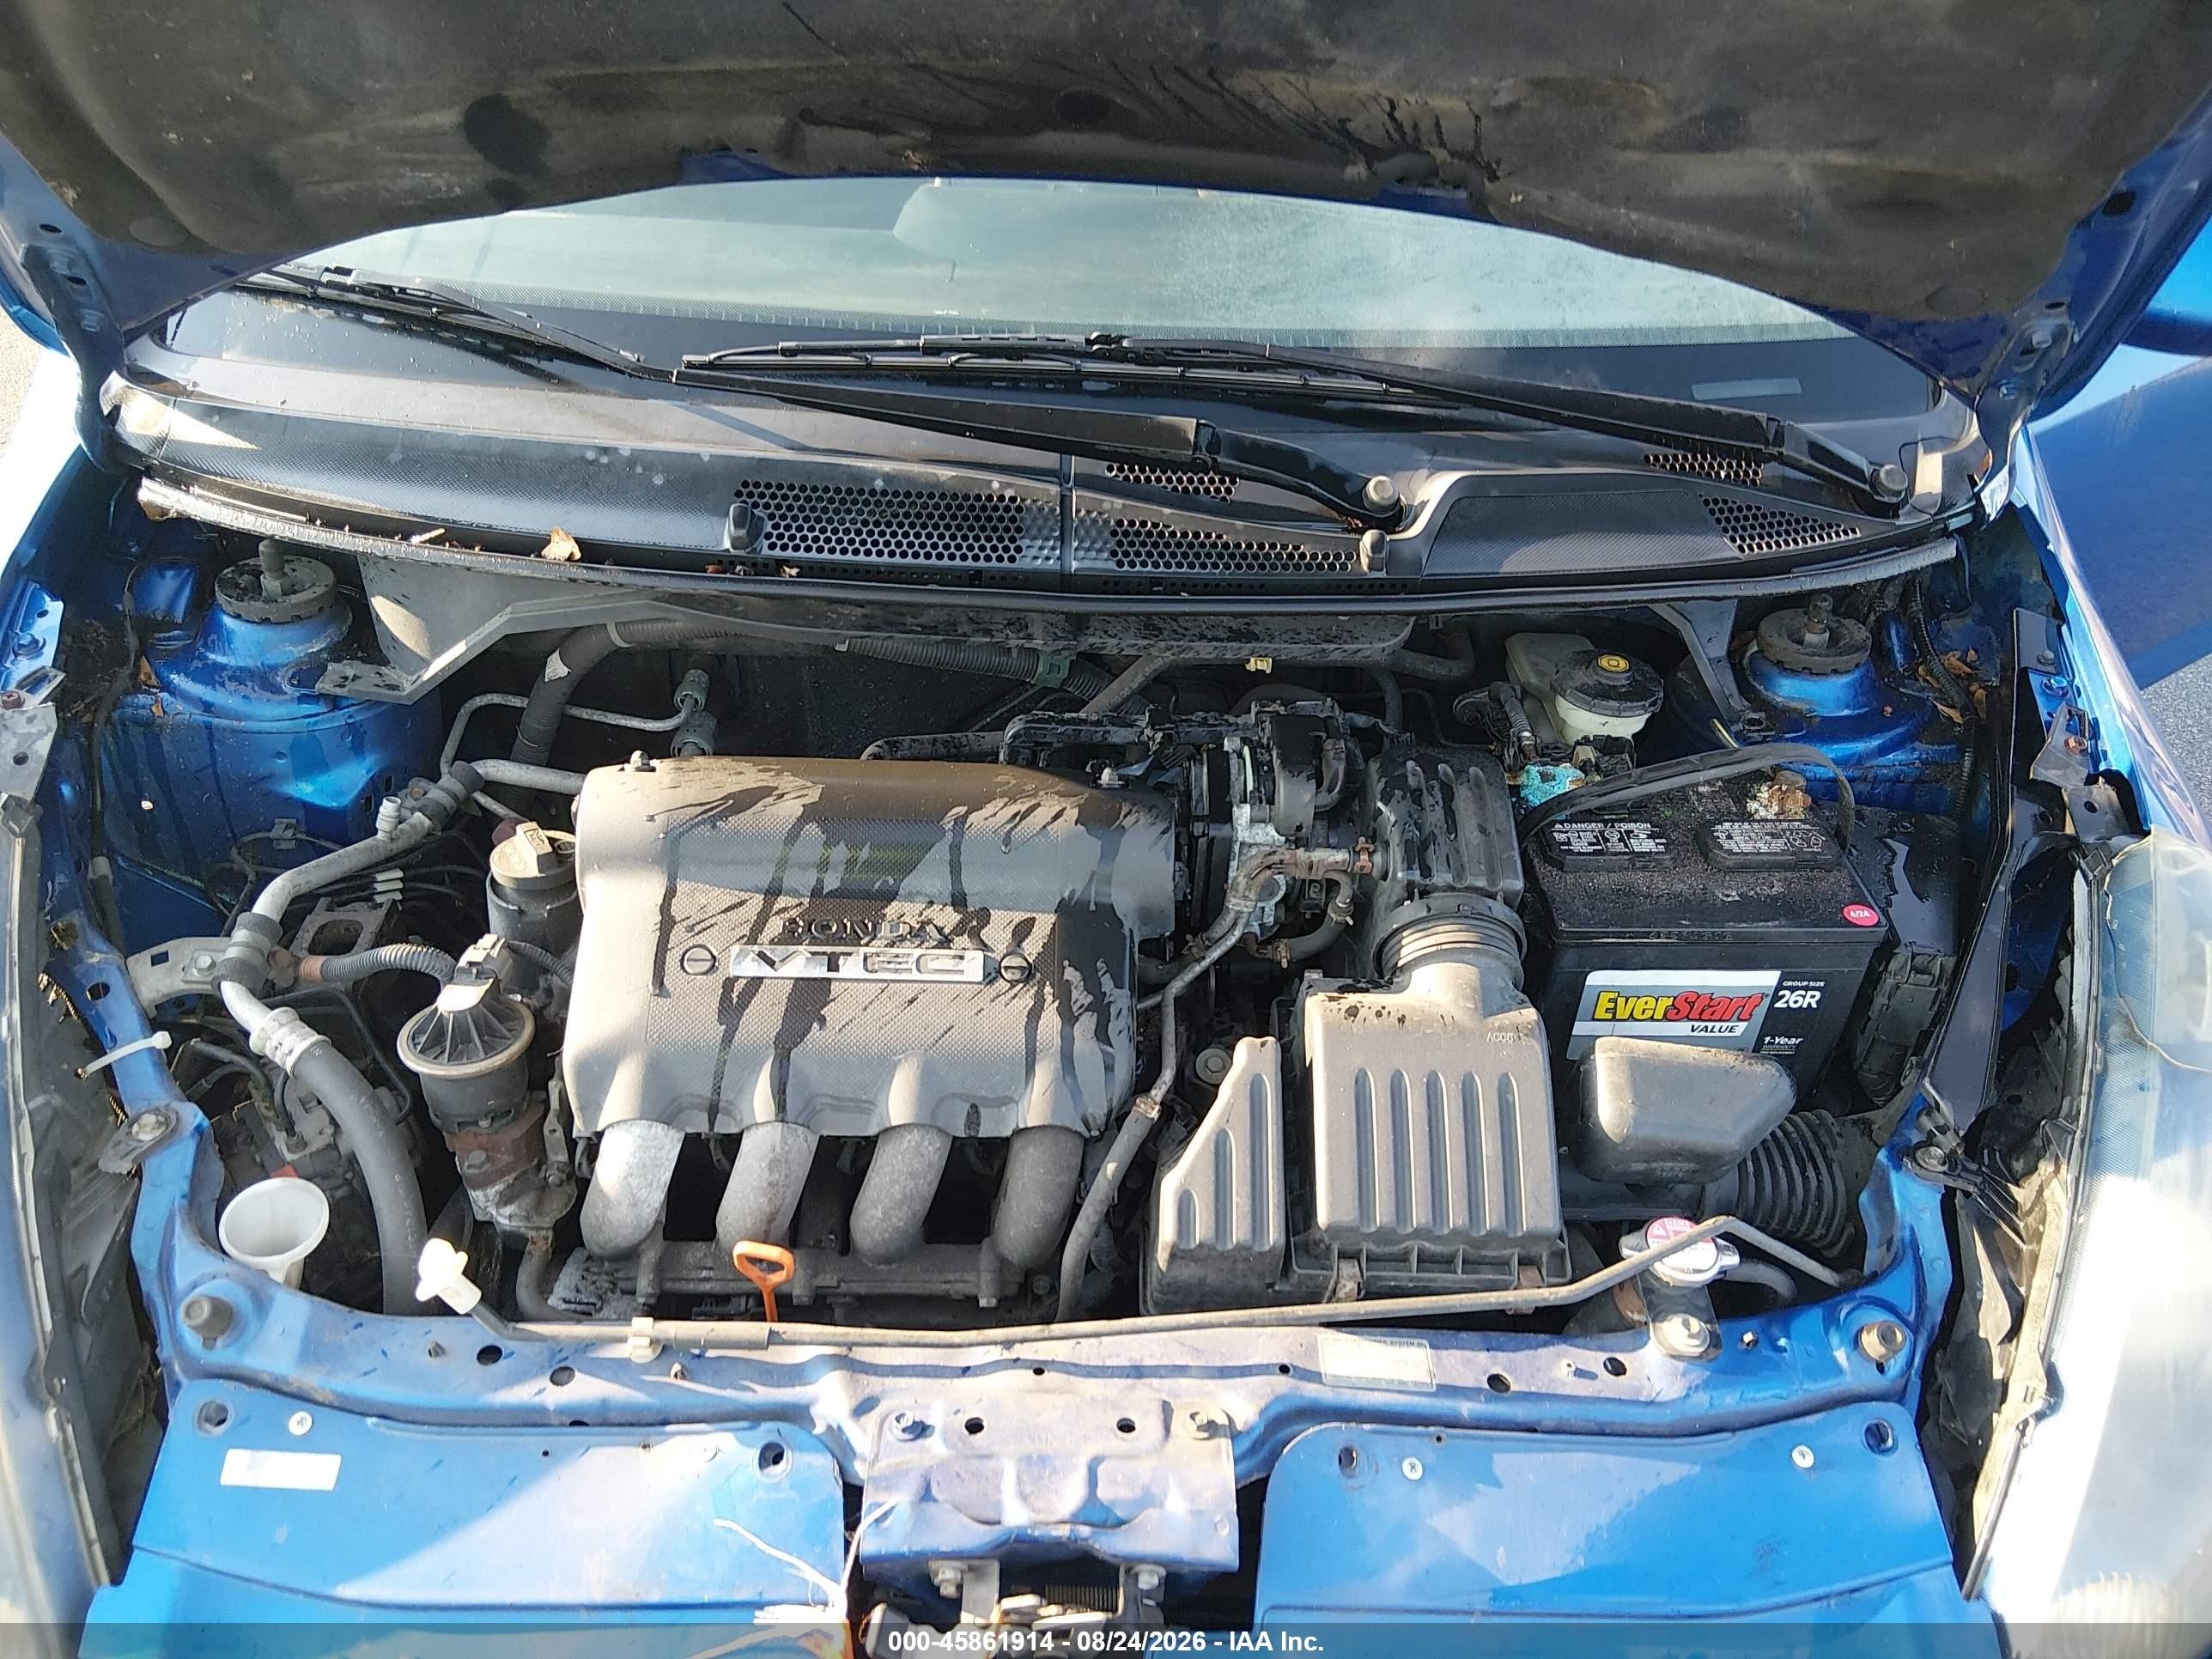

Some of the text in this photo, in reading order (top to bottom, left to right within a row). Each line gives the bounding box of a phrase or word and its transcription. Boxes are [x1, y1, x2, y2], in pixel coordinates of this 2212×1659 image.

[780, 917, 945, 942] HONDA
[750, 949, 966, 975] VTEC
[1593, 990, 1765, 1022] EverStart
[1773, 989, 1821, 1009] 26R
[1690, 1024, 1739, 1034] VALUE
[1763, 1036, 1803, 1045] 1-Year
